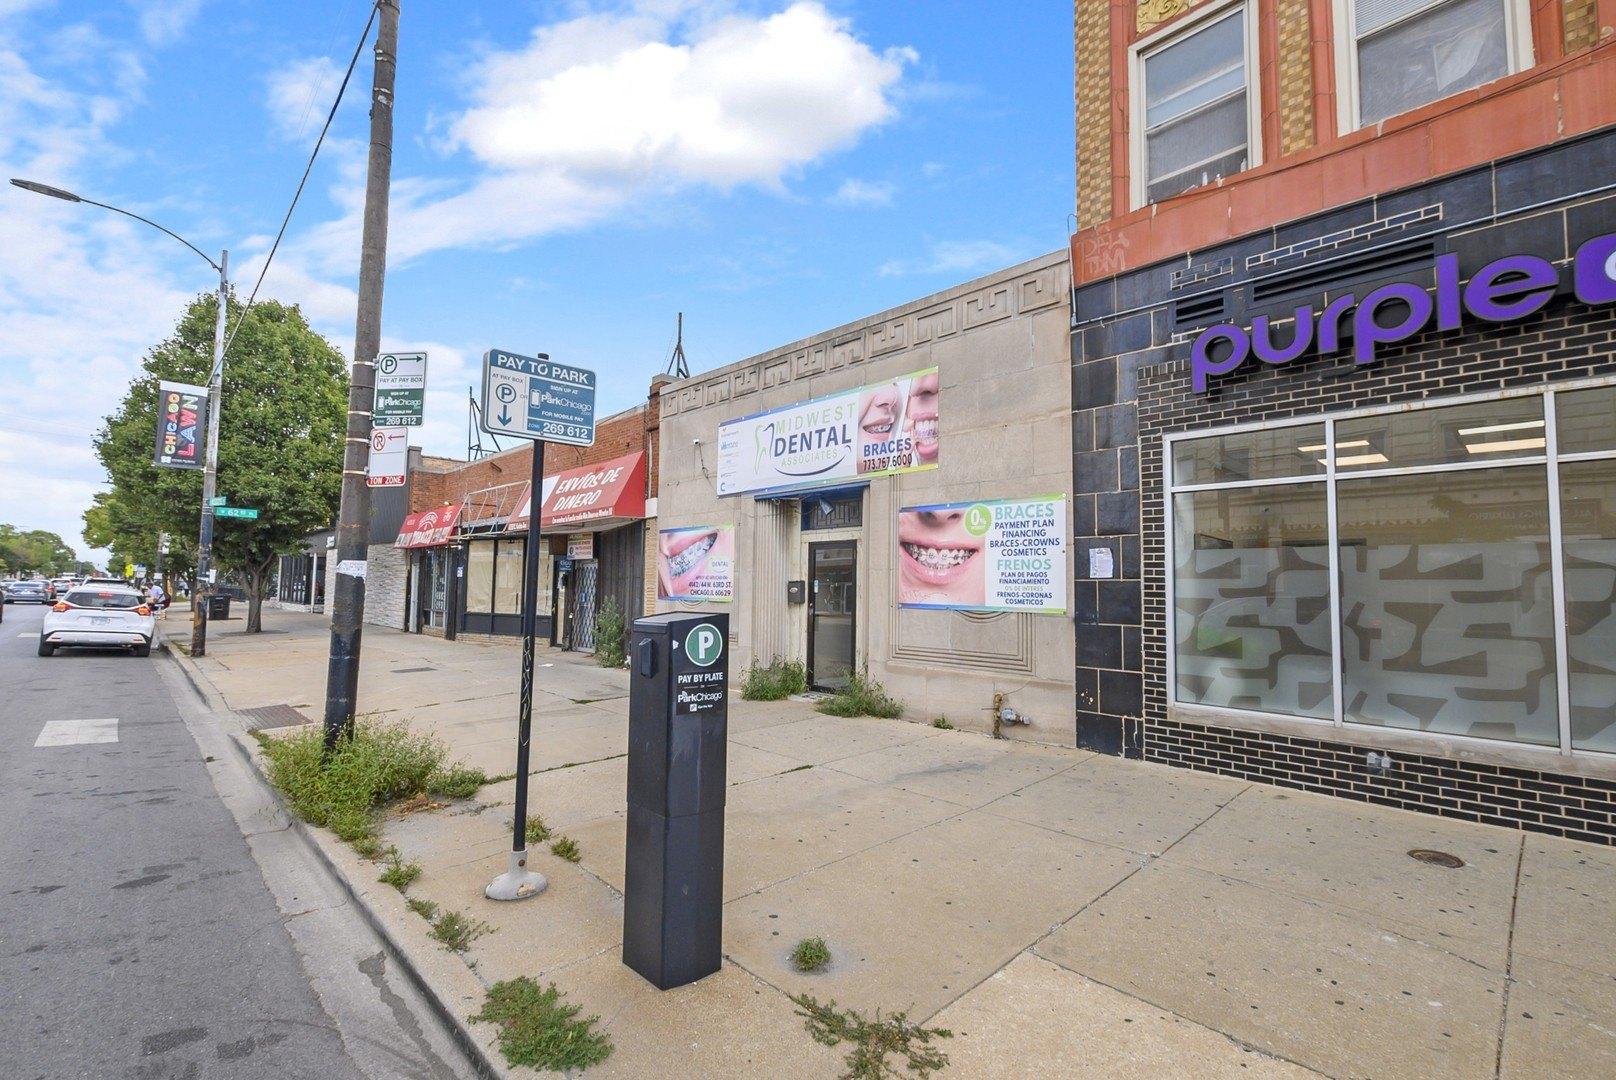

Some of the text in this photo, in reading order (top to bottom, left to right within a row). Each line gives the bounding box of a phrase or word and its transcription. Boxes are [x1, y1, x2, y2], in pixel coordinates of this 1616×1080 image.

[1191, 252, 1560, 394] purple
[497, 354, 589, 385] PAY TO PARK
[541, 392, 592, 412] ParkChicago
[164, 393, 180, 455] CHICAGO
[177, 395, 199, 457] LAWN
[386, 417, 401, 425] 269
[401, 417, 417, 425] 612
[776, 401, 857, 434] MIDWEST
[542, 423, 565, 435] 269
[567, 426, 588, 439] 612
[774, 423, 852, 458] DENTAL
[863, 437, 912, 457] BRACES
[781, 448, 838, 468] ASSOCIATES
[369, 475, 402, 485] TOW ZONE
[601, 466, 624, 486] DE
[552, 489, 603, 512] DINERO
[994, 503, 1055, 521] BRACES
[994, 518, 1055, 530] PAYMENT PLAN
[1001, 529, 1047, 538] FINANCING
[989, 538, 1060, 548] BRACES-CROWNS
[1001, 546, 1047, 557] COSMETICS
[997, 558, 1052, 571] FRENOS
[996, 591, 1053, 599] FRENOS-CORONAS
[1005, 598, 1044, 606] COSMETICOS
[698, 630, 714, 659] P
[677, 672, 724, 684] PAY BY PLATE
[677, 691, 723, 703] ParkChicago
